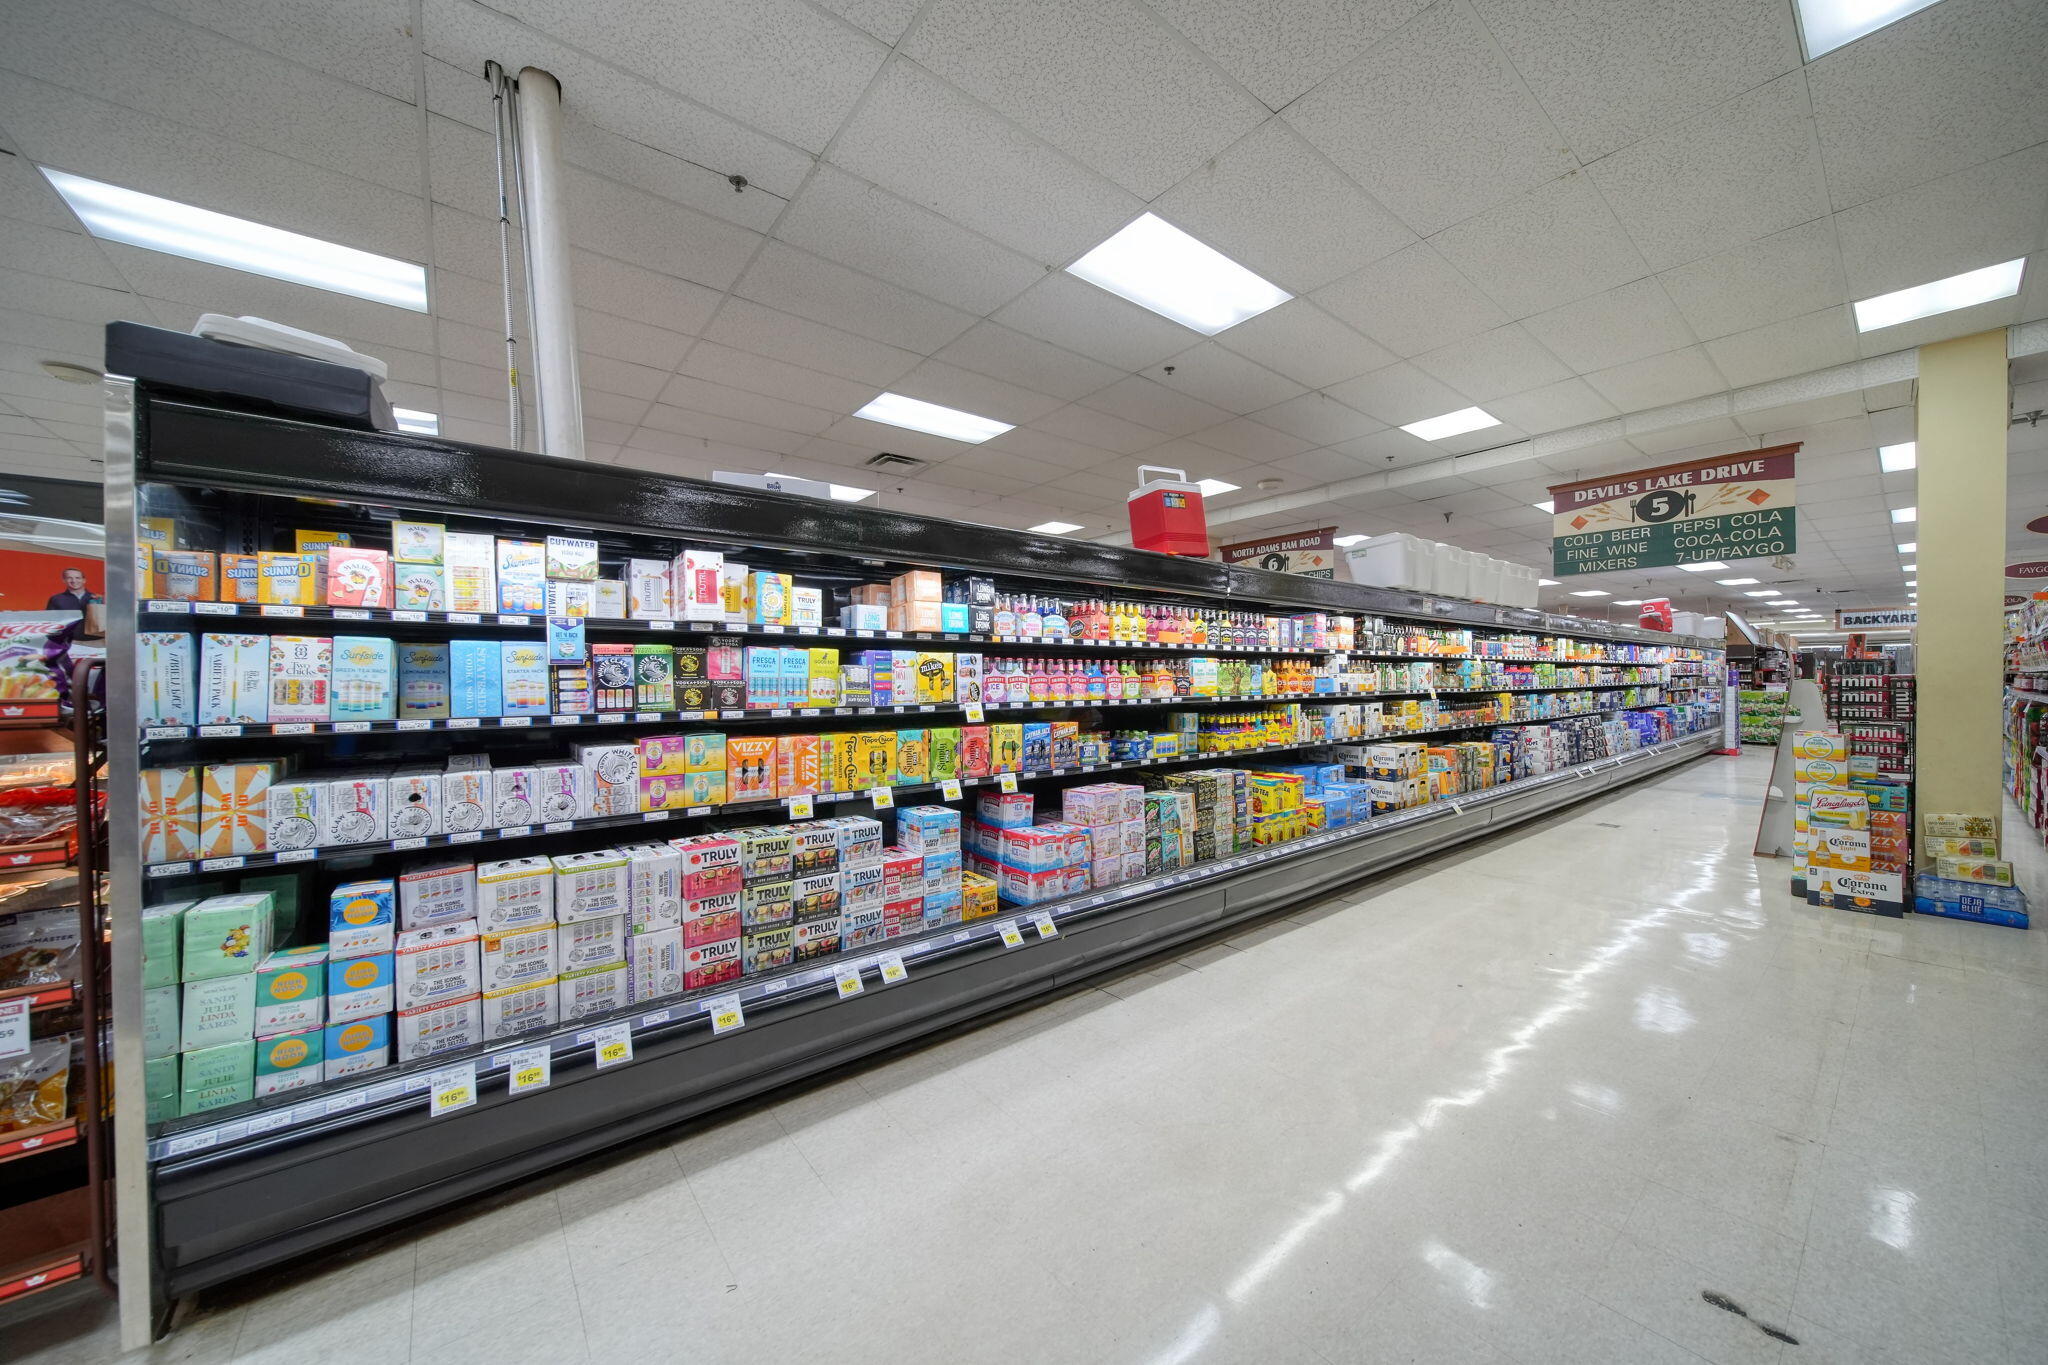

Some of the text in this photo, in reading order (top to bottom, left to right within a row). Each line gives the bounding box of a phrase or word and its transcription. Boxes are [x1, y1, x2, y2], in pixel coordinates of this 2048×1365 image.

[1574, 460, 1765, 502] DEVIL'S LAKE DRIVE
[1651, 497, 1669, 516] 5
[1673, 511, 1782, 534] PEPSI COLA
[550, 538, 595, 548] CUTWATER
[1563, 528, 1651, 547] COLD BEER
[1674, 527, 1782, 549] COCA-COLA
[1232, 537, 1320, 558] NORTH ADAMS RAM ROAD
[1567, 542, 1648, 560] FINE WINE
[1676, 542, 1785, 563] 7-UP/FAYGO
[1268, 558, 1278, 570] 6
[1579, 557, 1638, 573] MIXERS
[548, 580, 556, 615] UTWATER
[976, 613, 990, 621] LONG
[976, 621, 990, 630] DRINK
[341, 650, 384, 660] Surfside
[404, 651, 445, 664] Surfside
[506, 651, 544, 664] Surfside
[752, 656, 776, 664] FRESCA
[1842, 676, 1882, 687] mini
[1842, 692, 1882, 702] mini
[1842, 706, 1882, 718] mini
[1856, 727, 1897, 738] mini
[862, 735, 894, 744] Topo Chico
[732, 741, 772, 752] VIZZY
[1856, 742, 1897, 754] mini
[904, 744, 915, 774] Simply
[937, 744, 948, 772] Simply
[968, 740, 978, 768] Simply
[1373, 754, 1394, 762] Corona
[612, 749, 638, 782] WHITE CLAW
[806, 741, 818, 792] VIZZY
[844, 736, 858, 791] Topo Chico
[444, 804, 458, 822] CLAW
[496, 800, 508, 818] CLAW
[390, 810, 404, 828] CLAW
[1871, 812, 1901, 822] ZZY
[268, 820, 284, 840] CLAW
[331, 814, 345, 834] CLAW
[804, 832, 834, 844] TRULY
[1829, 836, 1868, 848] Corona
[1871, 836, 1902, 846] ZZY
[756, 840, 790, 854] TRULY
[702, 848, 738, 862] TRULY
[1871, 862, 1901, 872] ZZY
[804, 877, 834, 890] TRULY
[1838, 876, 1888, 892] Corona
[756, 886, 790, 900] TRULY
[1850, 886, 1876, 896] Extra
[444, 900, 462, 908] ICONIC
[700, 894, 736, 910] TRULY
[1962, 896, 1982, 906] DEJA
[445, 904, 464, 912] SELTZER
[1962, 904, 1982, 914] BLUE
[808, 922, 838, 936] TRULY
[758, 931, 790, 945] TRULY
[700, 942, 737, 958] TRULY
[529, 964, 548, 972] SELTZER
[430, 979, 466, 992] HARD SELTZER
[444, 975, 462, 983] ICONIC
[200, 1011, 236, 1022] LINDA
[526, 1016, 544, 1024] ICONIC
[528, 1020, 547, 1028] SELTZER
[200, 1086, 236, 1099] LINDA
